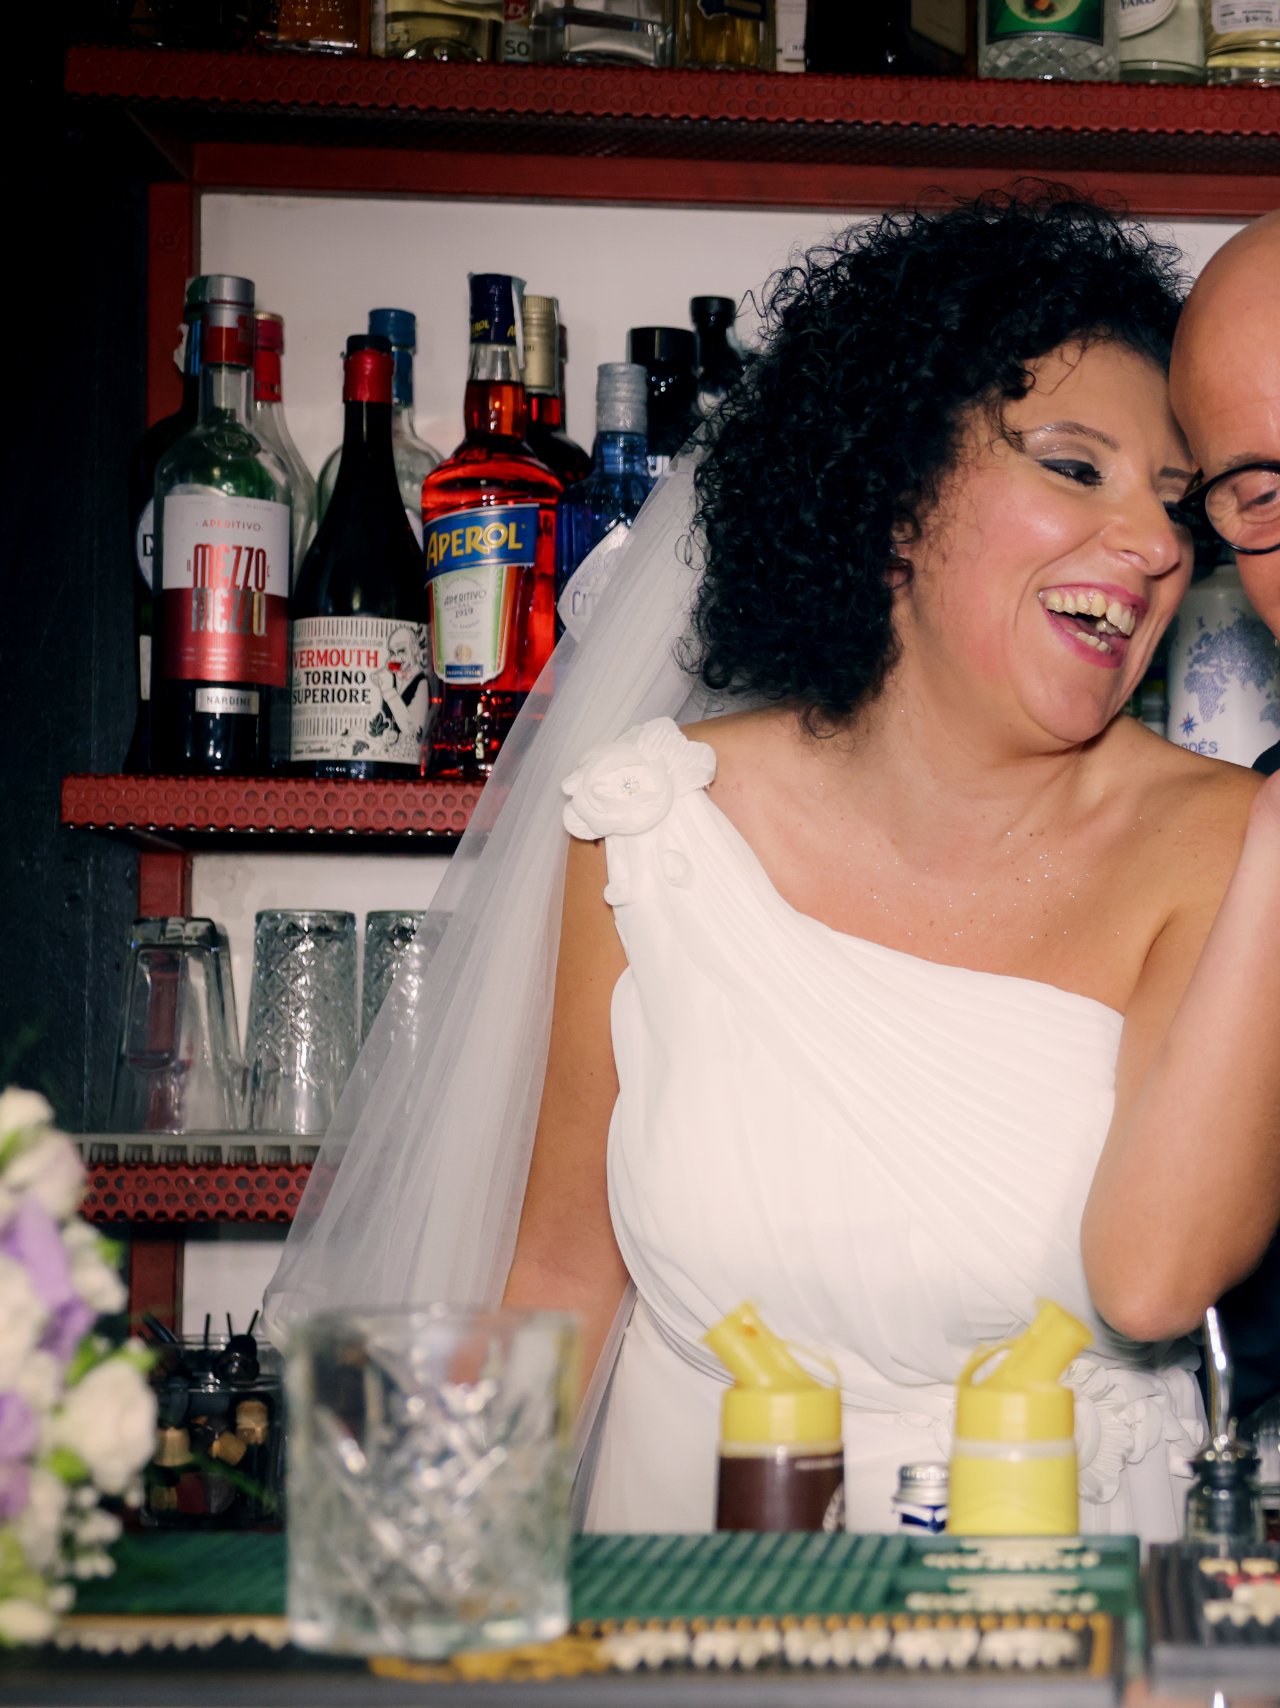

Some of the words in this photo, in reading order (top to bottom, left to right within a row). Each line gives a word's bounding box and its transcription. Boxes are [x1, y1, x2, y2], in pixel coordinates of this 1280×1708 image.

[202, 518, 262, 532] APERITIVO
[426, 522, 524, 571] APEROL
[193, 543, 267, 592] MEZZO
[443, 589, 487, 607] APERITIVO
[192, 588, 268, 637] MEZZO
[455, 607, 474, 619] 1919
[293, 648, 379, 669] VERMOUTH
[304, 671, 367, 687] TORINO
[206, 695, 252, 708] NARDINI
[292, 688, 372, 705] SUPERIORE
